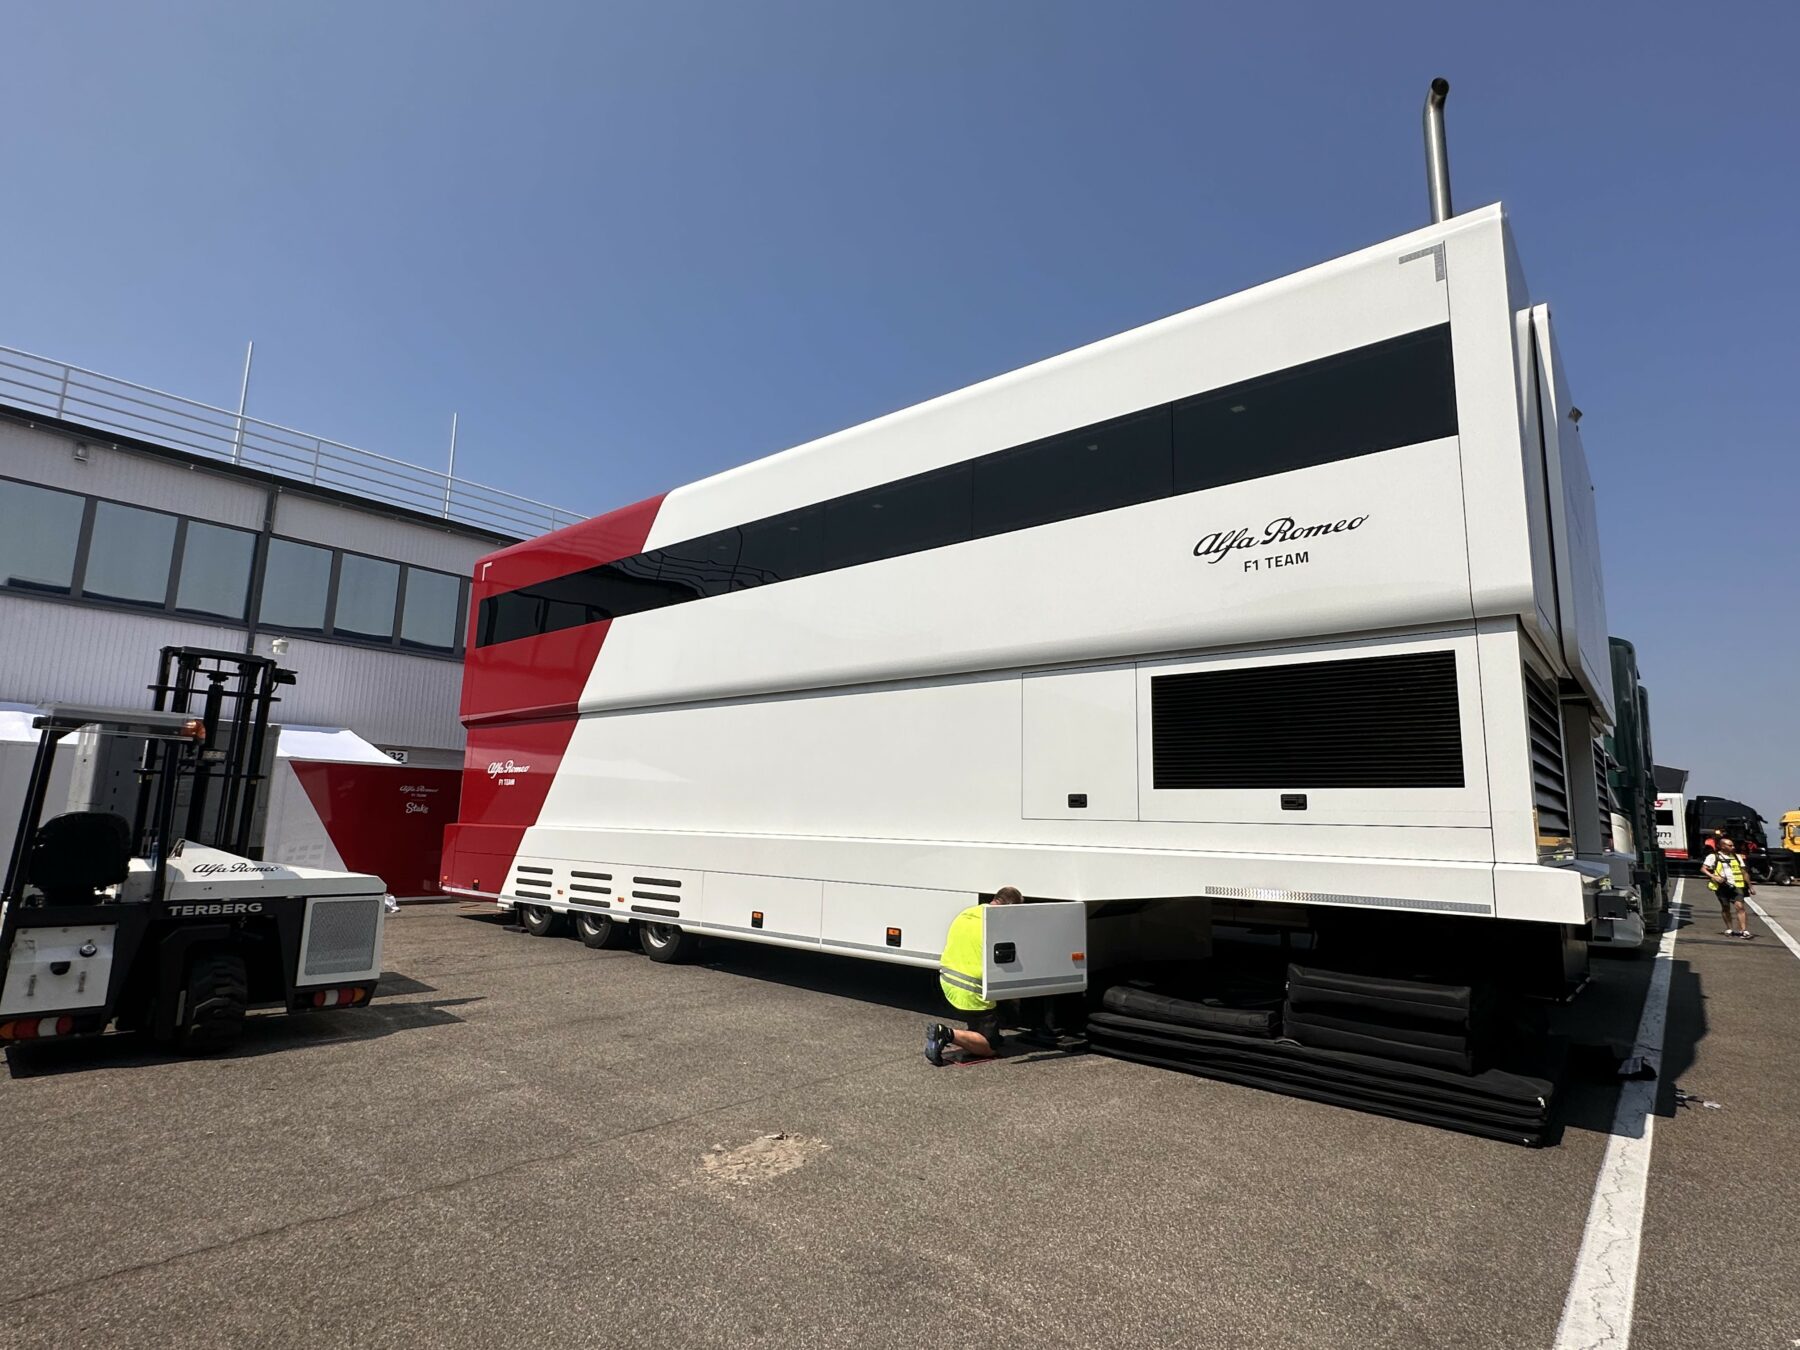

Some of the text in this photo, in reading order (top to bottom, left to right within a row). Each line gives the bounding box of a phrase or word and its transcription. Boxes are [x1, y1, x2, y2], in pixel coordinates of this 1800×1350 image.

[1193, 514, 1370, 564] Alfa Romeo
[1243, 551, 1309, 573] F1 TEAM
[390, 751, 404, 761] 32
[487, 762, 504, 779] Alfa
[192, 862, 281, 877] Alfa Romeo
[168, 902, 263, 916] TERBERG
